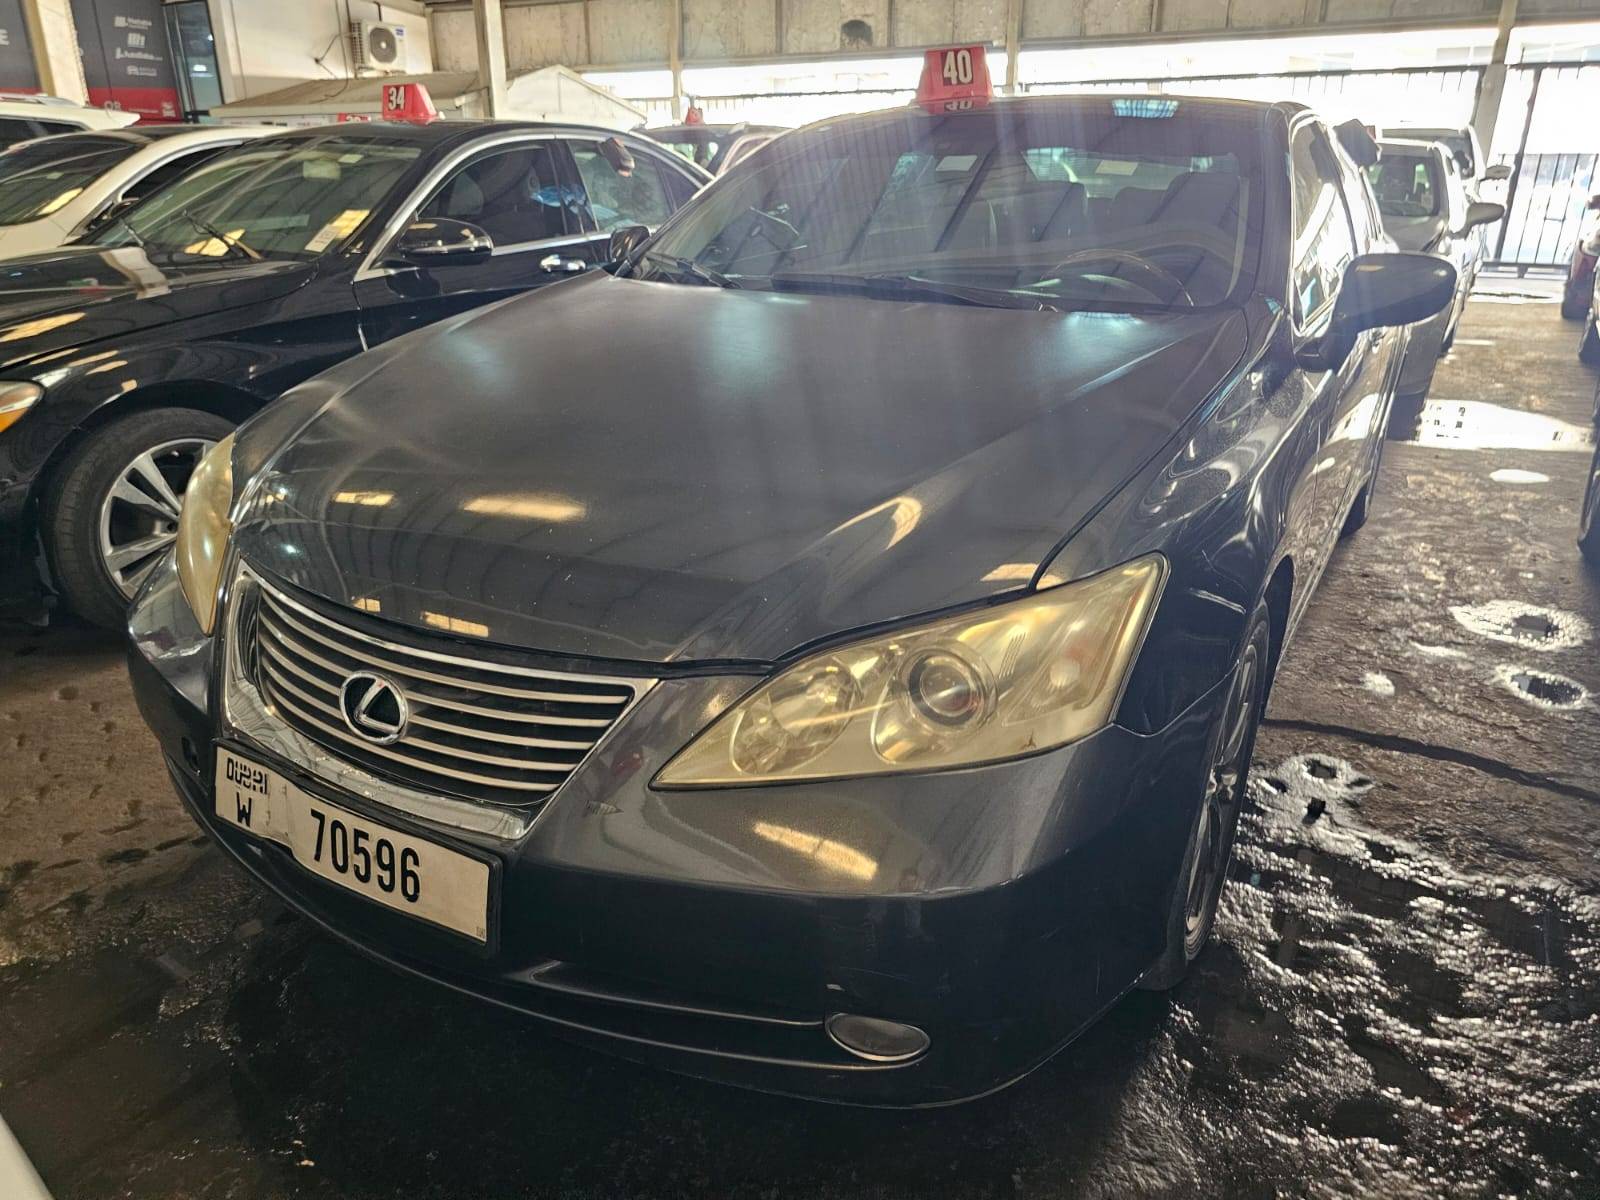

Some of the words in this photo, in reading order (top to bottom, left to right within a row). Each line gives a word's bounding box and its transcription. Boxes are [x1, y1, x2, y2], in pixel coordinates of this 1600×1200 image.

[943, 50, 972, 85] 40
[388, 86, 405, 110] 34
[236, 791, 252, 827] W
[310, 808, 421, 903] 70596
